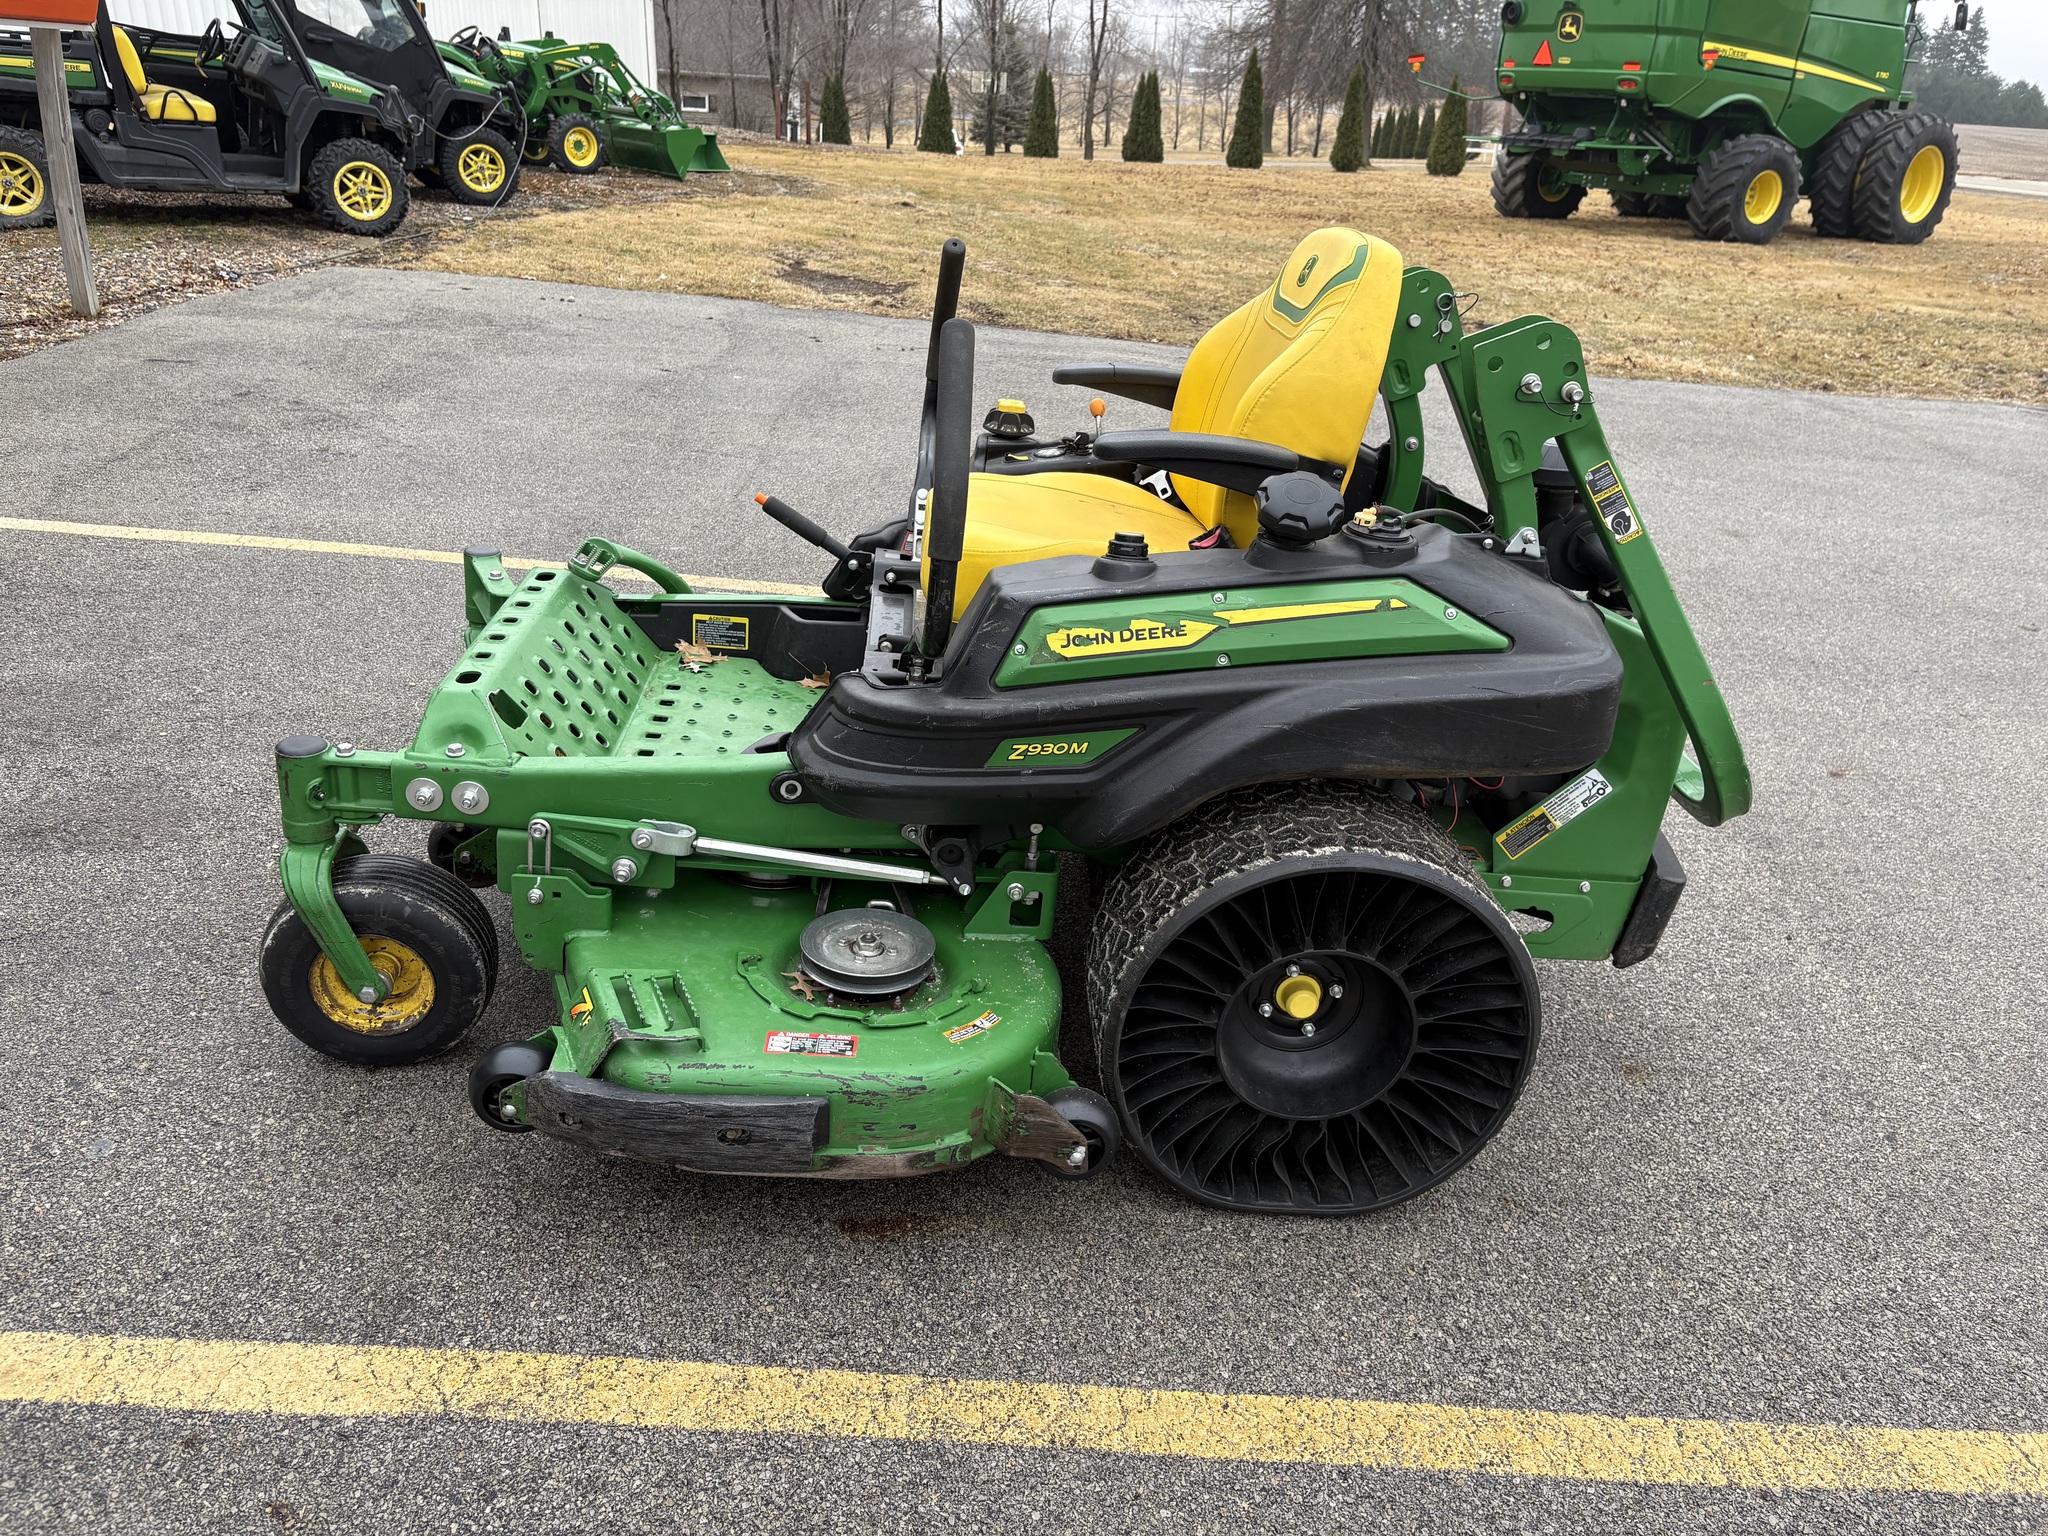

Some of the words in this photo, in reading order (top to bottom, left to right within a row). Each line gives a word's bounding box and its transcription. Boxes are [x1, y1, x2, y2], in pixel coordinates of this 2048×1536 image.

[1119, 624, 1187, 643] DEERE
[1007, 742, 1089, 760] Z930M
[1509, 813, 1536, 834] ATENCIÓN
